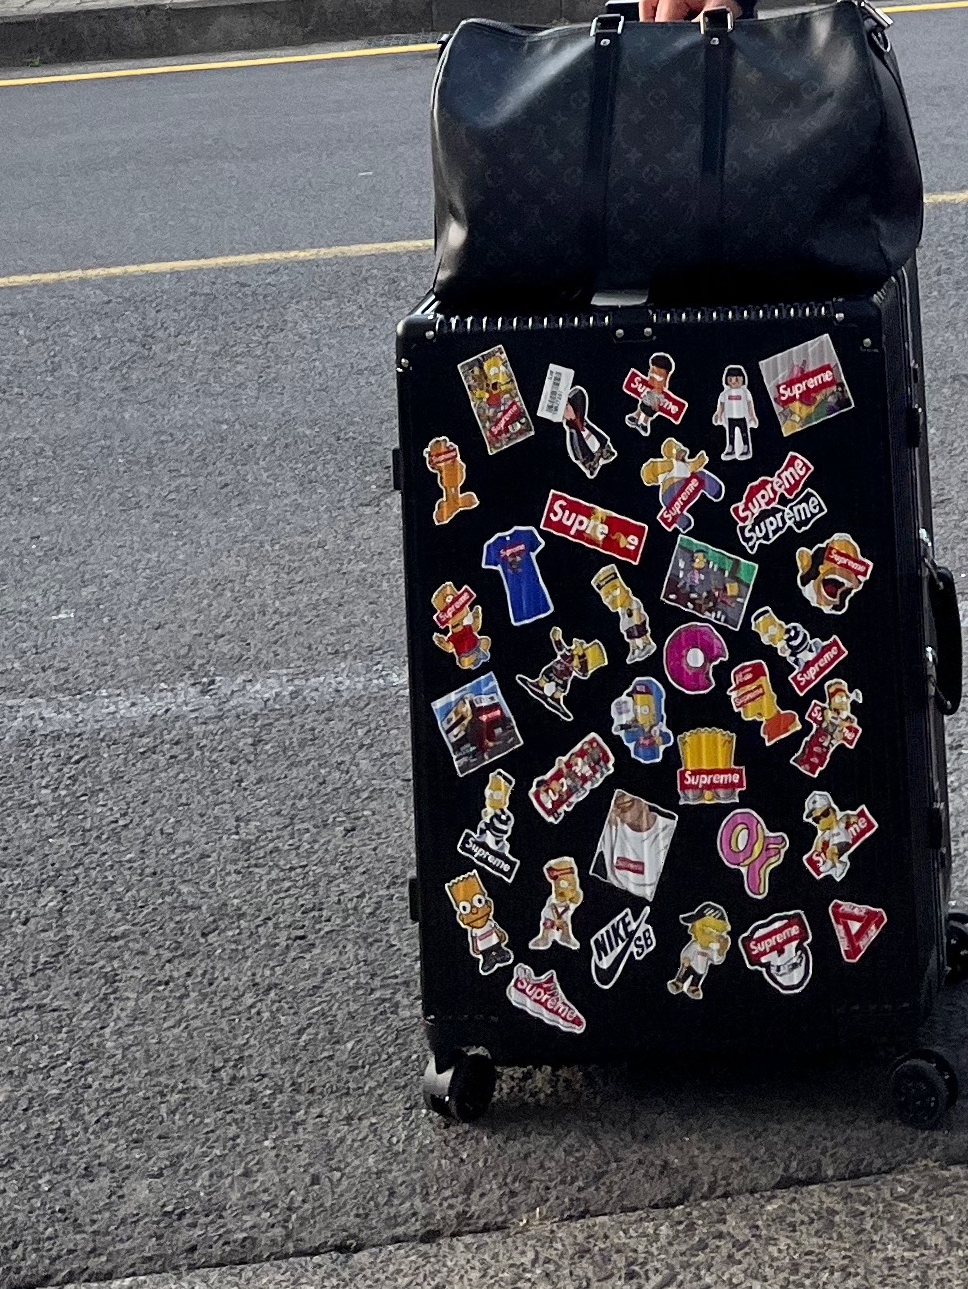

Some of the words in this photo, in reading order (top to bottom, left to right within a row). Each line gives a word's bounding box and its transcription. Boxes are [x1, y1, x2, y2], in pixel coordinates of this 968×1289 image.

[779, 368, 833, 401] Supreme
[663, 478, 699, 523] Supreme
[738, 458, 807, 525] Supreme
[549, 499, 640, 551] Supree
[744, 496, 820, 547] Supreme
[829, 549, 867, 573] Supreme
[438, 592, 470, 622] Supreme
[796, 645, 839, 687] Supreme
[684, 770, 740, 789] Supreme
[465, 837, 511, 872] Supreme
[593, 910, 634, 962] NIKE
[634, 928, 654, 957] SB
[749, 924, 800, 955] Supreme
[516, 977, 577, 1022] Supreme
